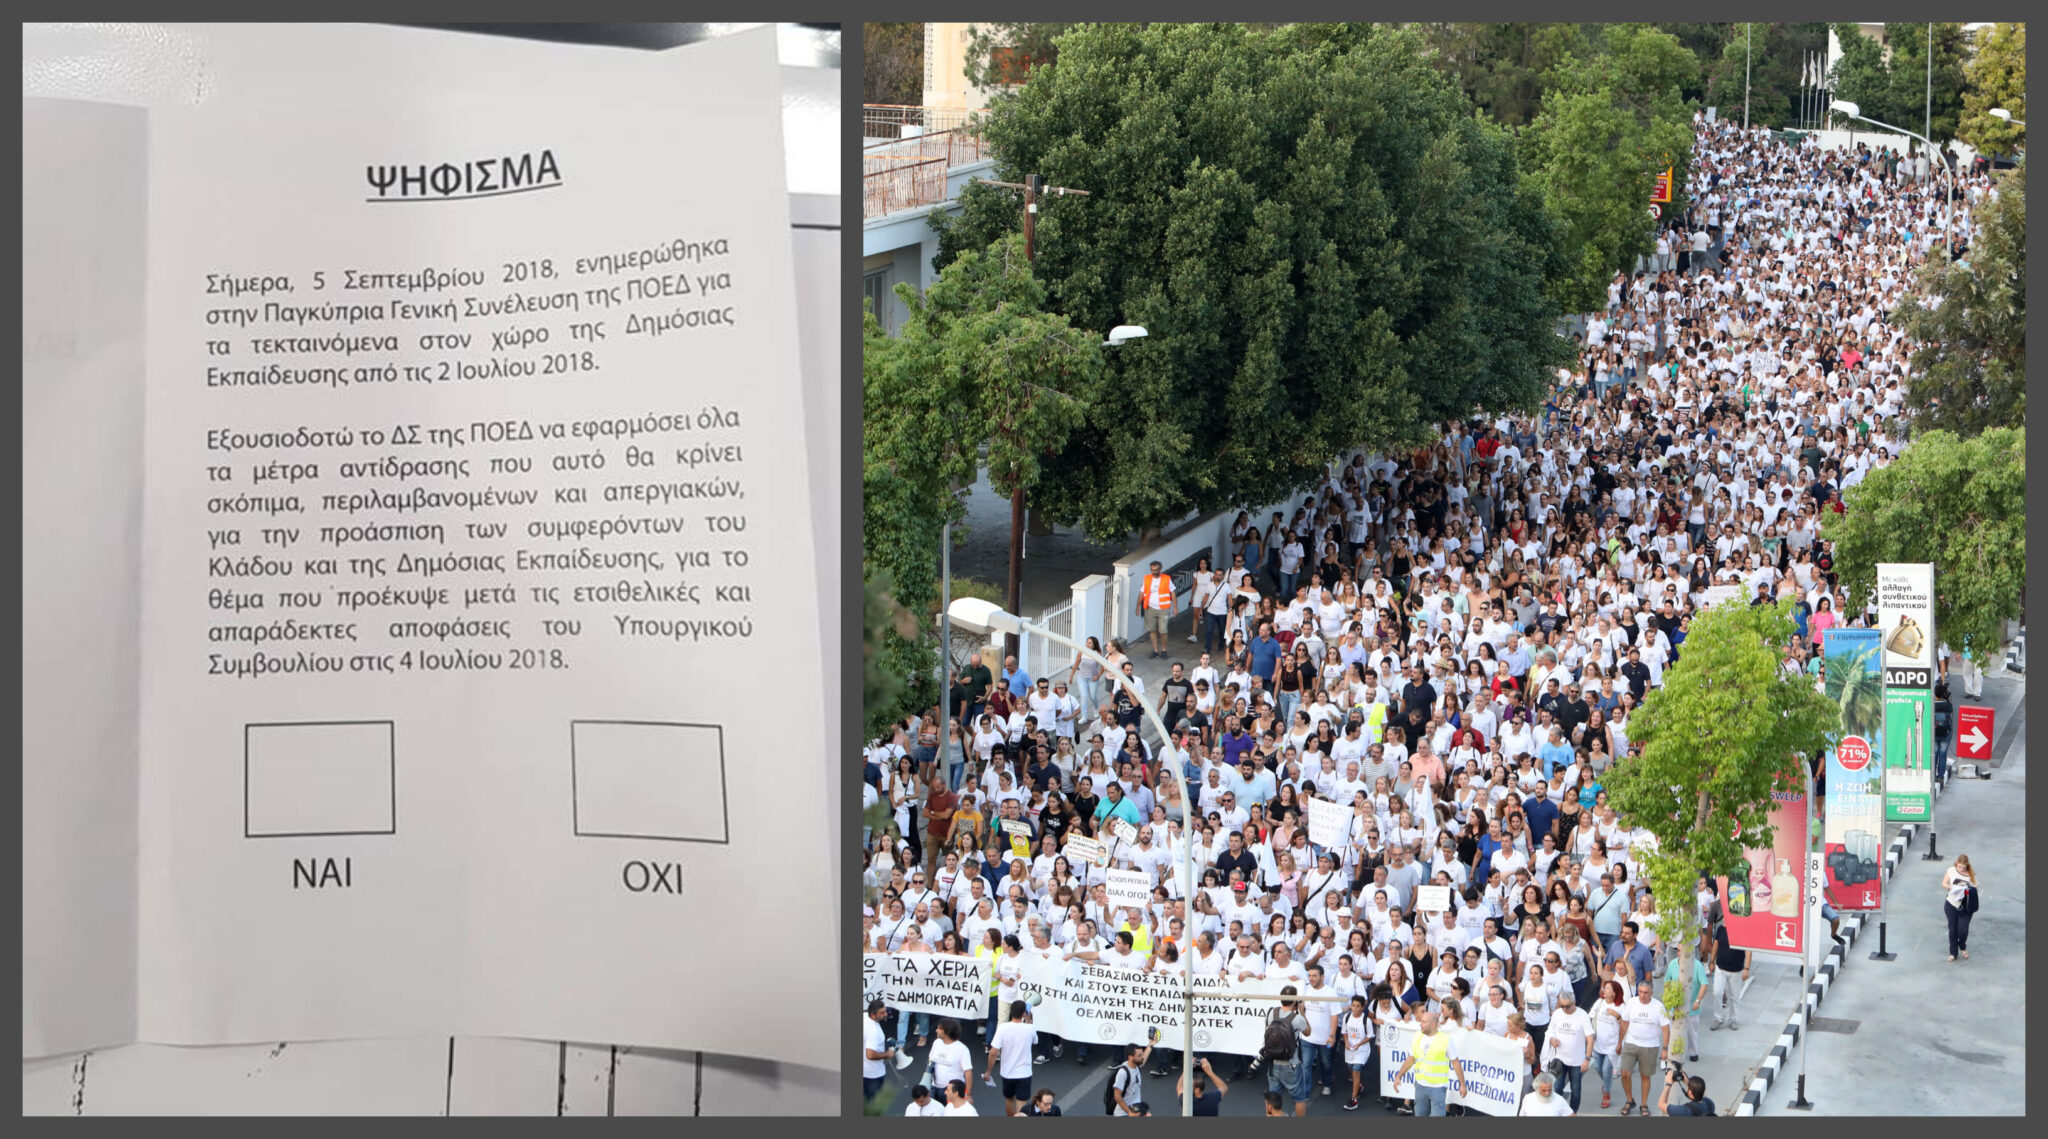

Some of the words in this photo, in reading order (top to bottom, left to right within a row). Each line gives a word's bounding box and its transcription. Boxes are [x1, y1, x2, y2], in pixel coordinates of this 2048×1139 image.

[366, 149, 561, 197] ΨΗΦΙΣΜΑ
[206, 274, 294, 297] Σήμερα,
[313, 272, 325, 290] 5
[344, 268, 484, 292] Σεπτεμβρίου
[503, 259, 558, 283] 2018,
[576, 239, 729, 275] ενημερώθηκα
[206, 309, 258, 328] στην
[265, 301, 384, 326] Παγκύπρια
[391, 299, 457, 322] Γενική
[464, 292, 578, 317] Συνέλευση
[585, 287, 621, 308] της
[627, 274, 691, 300] ΠΟΕΔ
[697, 274, 731, 296] για
[206, 341, 230, 355] τα
[251, 333, 398, 356] τεκταινόμενα
[420, 334, 471, 350] στον
[492, 326, 549, 351] χώρο
[569, 322, 605, 342] της
[626, 307, 734, 336] Δημόσιας
[208, 364, 348, 388] Εκπαίδευσης
[354, 363, 397, 383] από
[403, 367, 432, 383] τις
[438, 362, 450, 381] 2
[457, 358, 535, 380] Ιουλίου
[543, 351, 599, 374] 2018.
[208, 426, 353, 452] Εξουσιοδοτώ
[359, 430, 384, 445] το
[391, 425, 422, 445] ΔΣ
[427, 428, 464, 448] της
[471, 421, 533, 442] ΠΟΕΔ
[539, 423, 565, 439] να
[572, 412, 691, 441] εφαρμόσει
[697, 406, 740, 429] όλα
[207, 466, 231, 481] τα
[253, 460, 318, 485] μέτρα
[340, 456, 469, 481] αντίδρασης
[490, 458, 532, 473] που
[553, 449, 605, 471] αυτό
[626, 445, 654, 467] θα
[677, 442, 742, 469] κρίνει
[208, 493, 305, 516] σκόπιμα,
[322, 486, 538, 515] περιλαμβανομένων
[555, 488, 587, 503] και
[604, 476, 744, 505] απεργιακών,
[208, 530, 240, 550] για
[261, 529, 299, 548] την
[320, 522, 444, 547] προάσπιση
[465, 523, 507, 539] των
[528, 515, 684, 541] συμφερόντων
[705, 516, 746, 532] του
[209, 555, 292, 577] Κλάδου
[305, 560, 337, 575] και
[348, 558, 386, 578] της
[397, 552, 505, 577] Δημόσιας
[517, 547, 664, 573] Εκπαίδευσης,
[675, 552, 710, 572] για
[722, 551, 748, 566] το
[209, 588, 264, 613] θέμα
[279, 593, 321, 607] που
[337, 586, 449, 611] προέκυψε
[465, 583, 516, 609] μετά
[531, 587, 559, 605] τις
[574, 580, 700, 604] ετσιθελικές
[716, 586, 750, 602] και
[209, 619, 357, 645] απαράδεκτες
[389, 617, 510, 641] αποφάσεις
[542, 621, 581, 635] του
[614, 616, 752, 642] Υπουργικού
[208, 652, 343, 679] Συμβουλίου
[350, 655, 394, 674] στις
[400, 651, 413, 670] 4
[420, 648, 502, 670] Ιουλίου
[509, 649, 569, 669] 2018.
[1886, 671, 1927, 685] ΔΩΡΟ
[1840, 749, 1867, 758] 71%
[293, 857, 351, 889] ΝΑΙ
[623, 861, 682, 895] ΟΧΙ
[881, 974, 914, 986] ΤΗΝ
[924, 977, 983, 995] ΠΑΙΔΕΙΑ
[892, 957, 918, 973] ΤΑ
[928, 959, 979, 980] ΧΕΡΙΑ
[1081, 966, 1149, 983] ΣΕΒΑΣΜΟΣ
[1153, 975, 1178, 987] ΣΤΑ
[1183, 977, 1230, 988] ΑΙΔΙΑ
[1044, 986, 1068, 1000] ΣΤΗ
[1071, 992, 1125, 1008] ΔΙΑΛΥΣΗ
[1130, 999, 1154, 1010] ΤΗΣ
[1234, 1006, 1266, 1018] ΠΑΙΔ
[1064, 978, 1084, 989] ΚΑΙ
[1087, 980, 1128, 994] ΣΤΟΥΣ
[1076, 1008, 1132, 1022] ΟΕΛΜΕΚ
